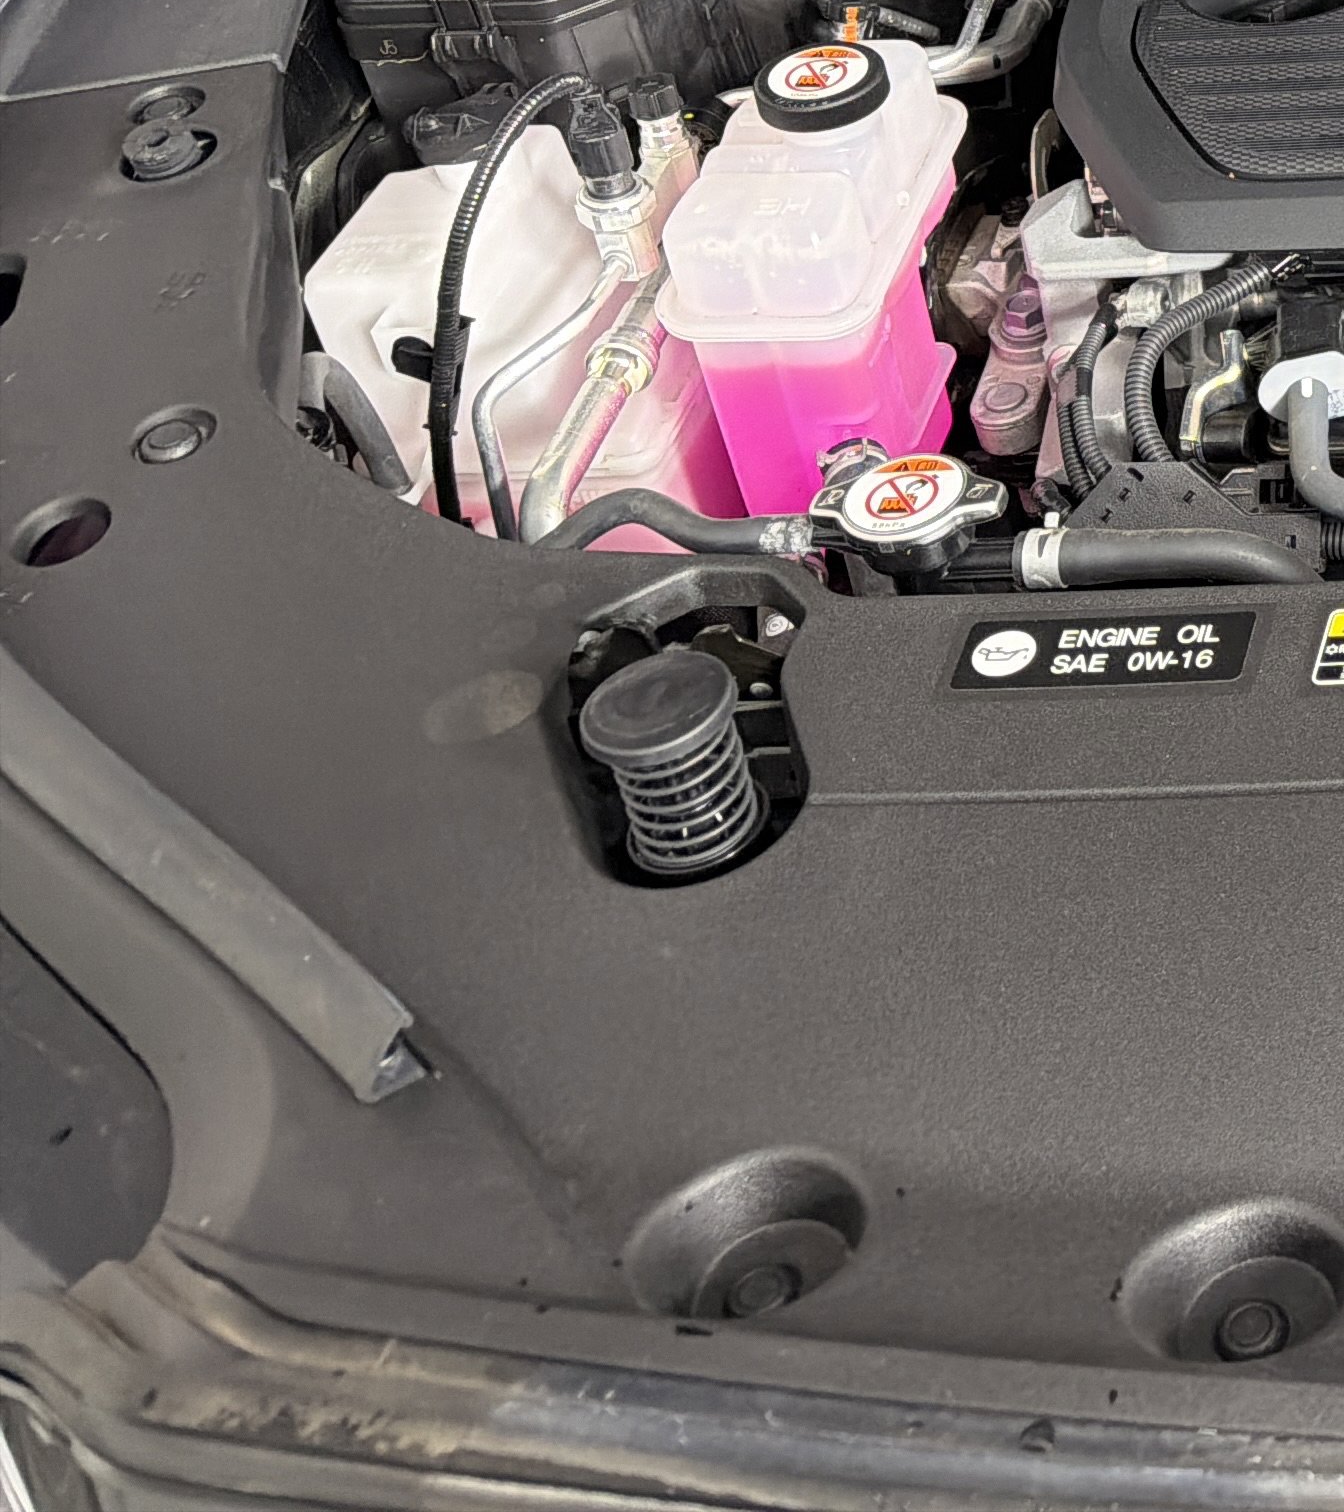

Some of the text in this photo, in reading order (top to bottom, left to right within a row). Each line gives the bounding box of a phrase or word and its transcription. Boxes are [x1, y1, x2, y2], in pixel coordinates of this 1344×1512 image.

[1058, 624, 1220, 649] ENGINE OIL
[1050, 649, 1214, 674] SAE 0W-16
